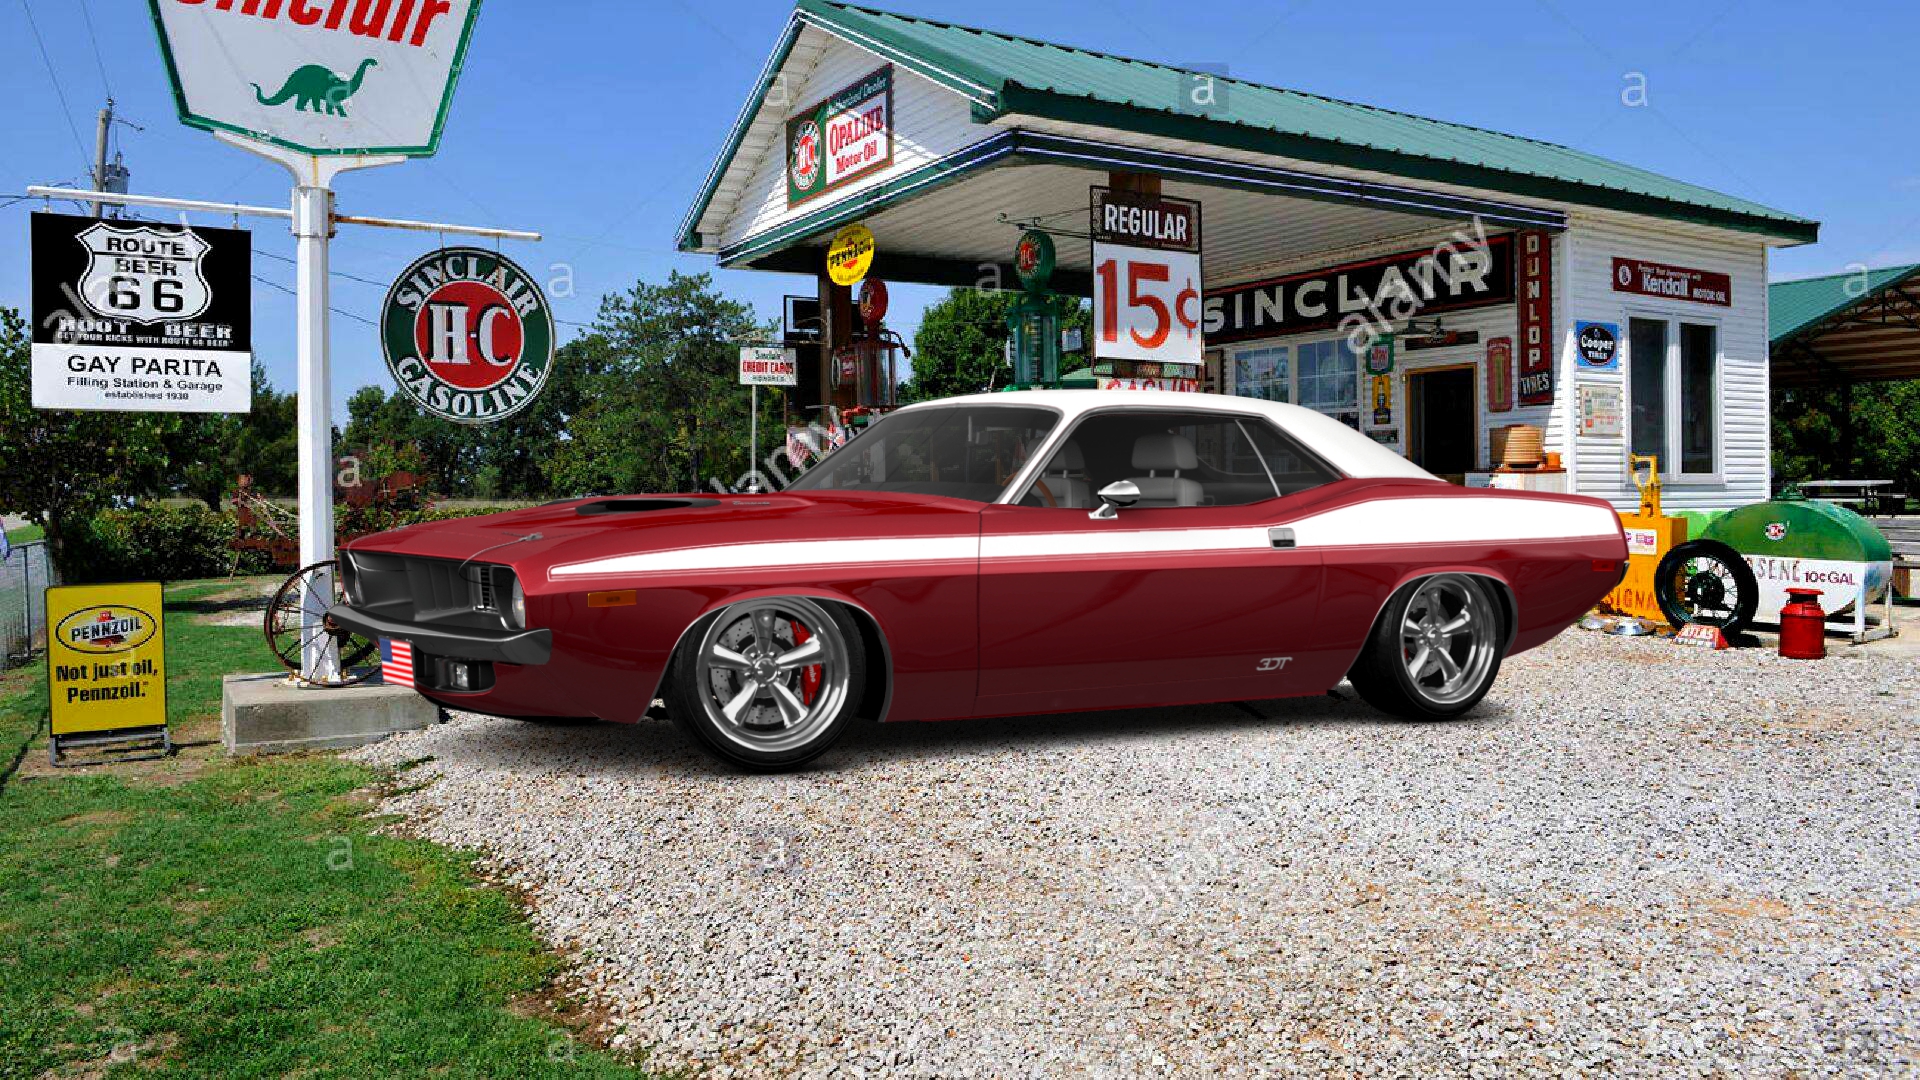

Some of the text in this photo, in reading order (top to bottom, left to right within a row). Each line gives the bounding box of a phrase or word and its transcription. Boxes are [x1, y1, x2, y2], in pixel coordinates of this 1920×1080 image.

[830, 105, 884, 156] OPALINE
[1105, 203, 1187, 241] REGULAR
[107, 237, 186, 256] ROUTE
[115, 257, 178, 276] BEER
[109, 276, 184, 312] 66
[397, 256, 539, 318] SINCLAIR
[1203, 253, 1489, 333] SINCLAIR
[1642, 271, 1688, 296] Kendall
[1096, 259, 1199, 349] 15¢
[1526, 234, 1541, 367] DUNLOP
[58, 316, 233, 339] ROOT BEER
[78, 332, 103, 342] YOUR
[105, 334, 133, 343] KICKS
[136, 336, 159, 345] WITH
[161, 337, 190, 346] ROUTE
[1581, 334, 1614, 351] Cooper
[67, 354, 223, 377] GAY PARITA
[742, 361, 768, 373] CREDIT
[67, 376, 223, 393] Filling Station & Garage
[104, 391, 163, 400] established
[397, 356, 542, 416] GASOLINE
[1520, 371, 1550, 396] TIRES
[1827, 571, 1856, 585] GAL
[71, 617, 143, 642] PENNZOIL
[55, 659, 158, 682] Not just oil,
